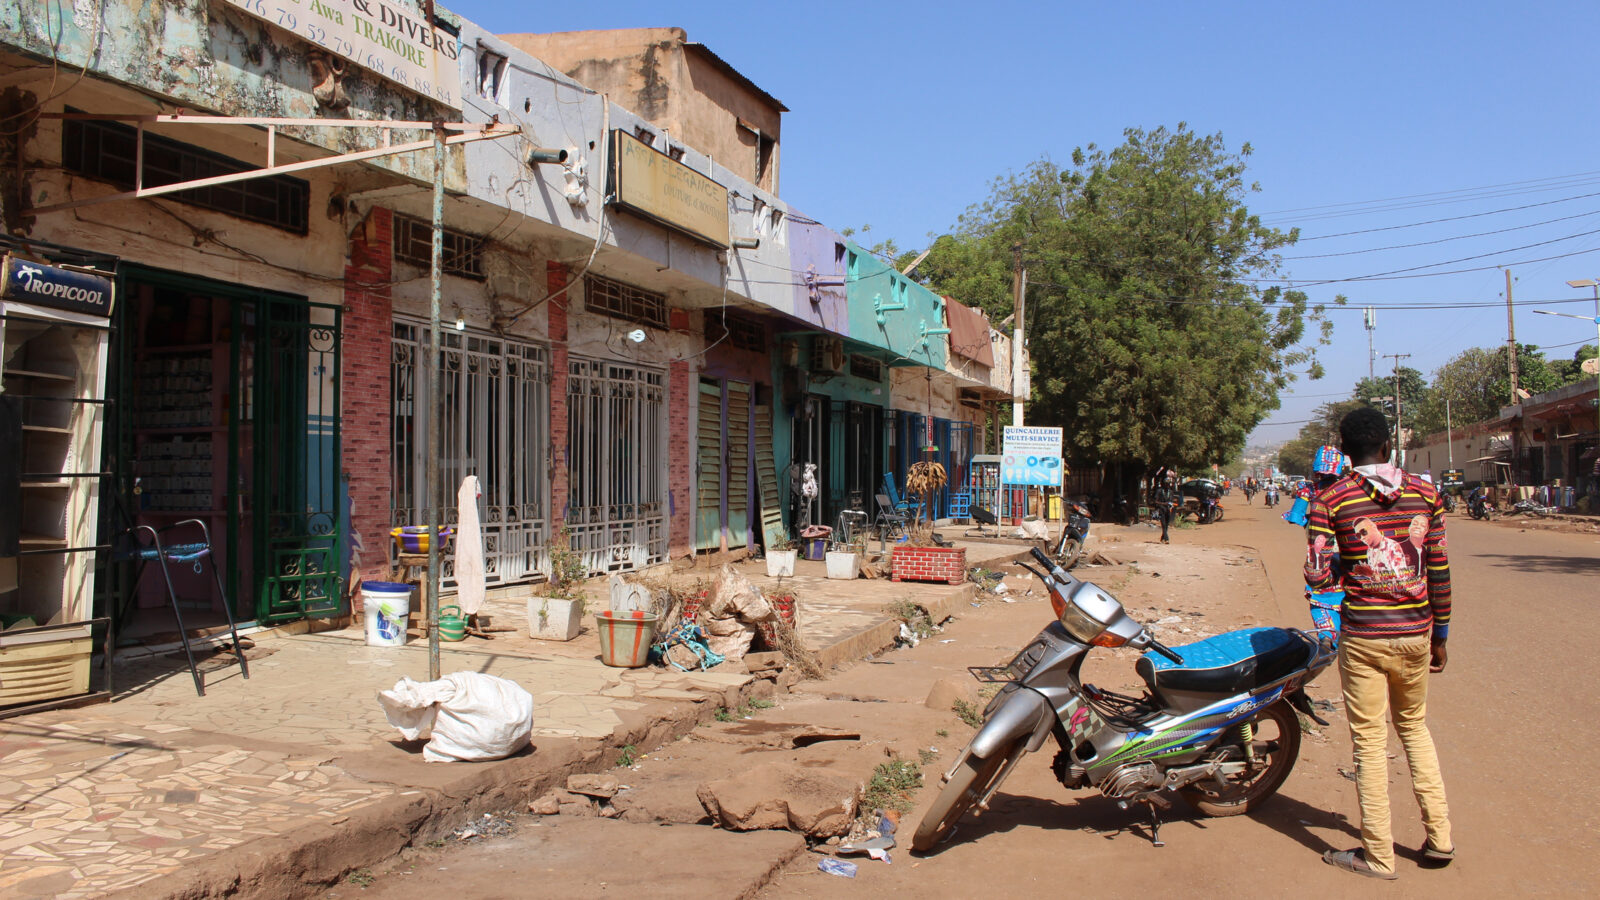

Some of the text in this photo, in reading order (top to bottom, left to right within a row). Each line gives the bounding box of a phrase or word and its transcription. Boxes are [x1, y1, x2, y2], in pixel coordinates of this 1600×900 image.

[276, 7, 298, 30] 79
[308, 23, 326, 46] 52
[334, 36, 353, 57] 79
[368, 54, 385, 74] 68
[391, 66, 408, 85] 68
[310, 0, 427, 69] Awa TRAKORE
[379, 2, 457, 61] DIVERS
[17, 264, 104, 305] TROPICOOL
[1005, 427, 1061, 435] QUINCAILLERIE
[1005, 435, 1060, 443] MULTI-SERVICE
[1165, 745, 1183, 754] KTM
